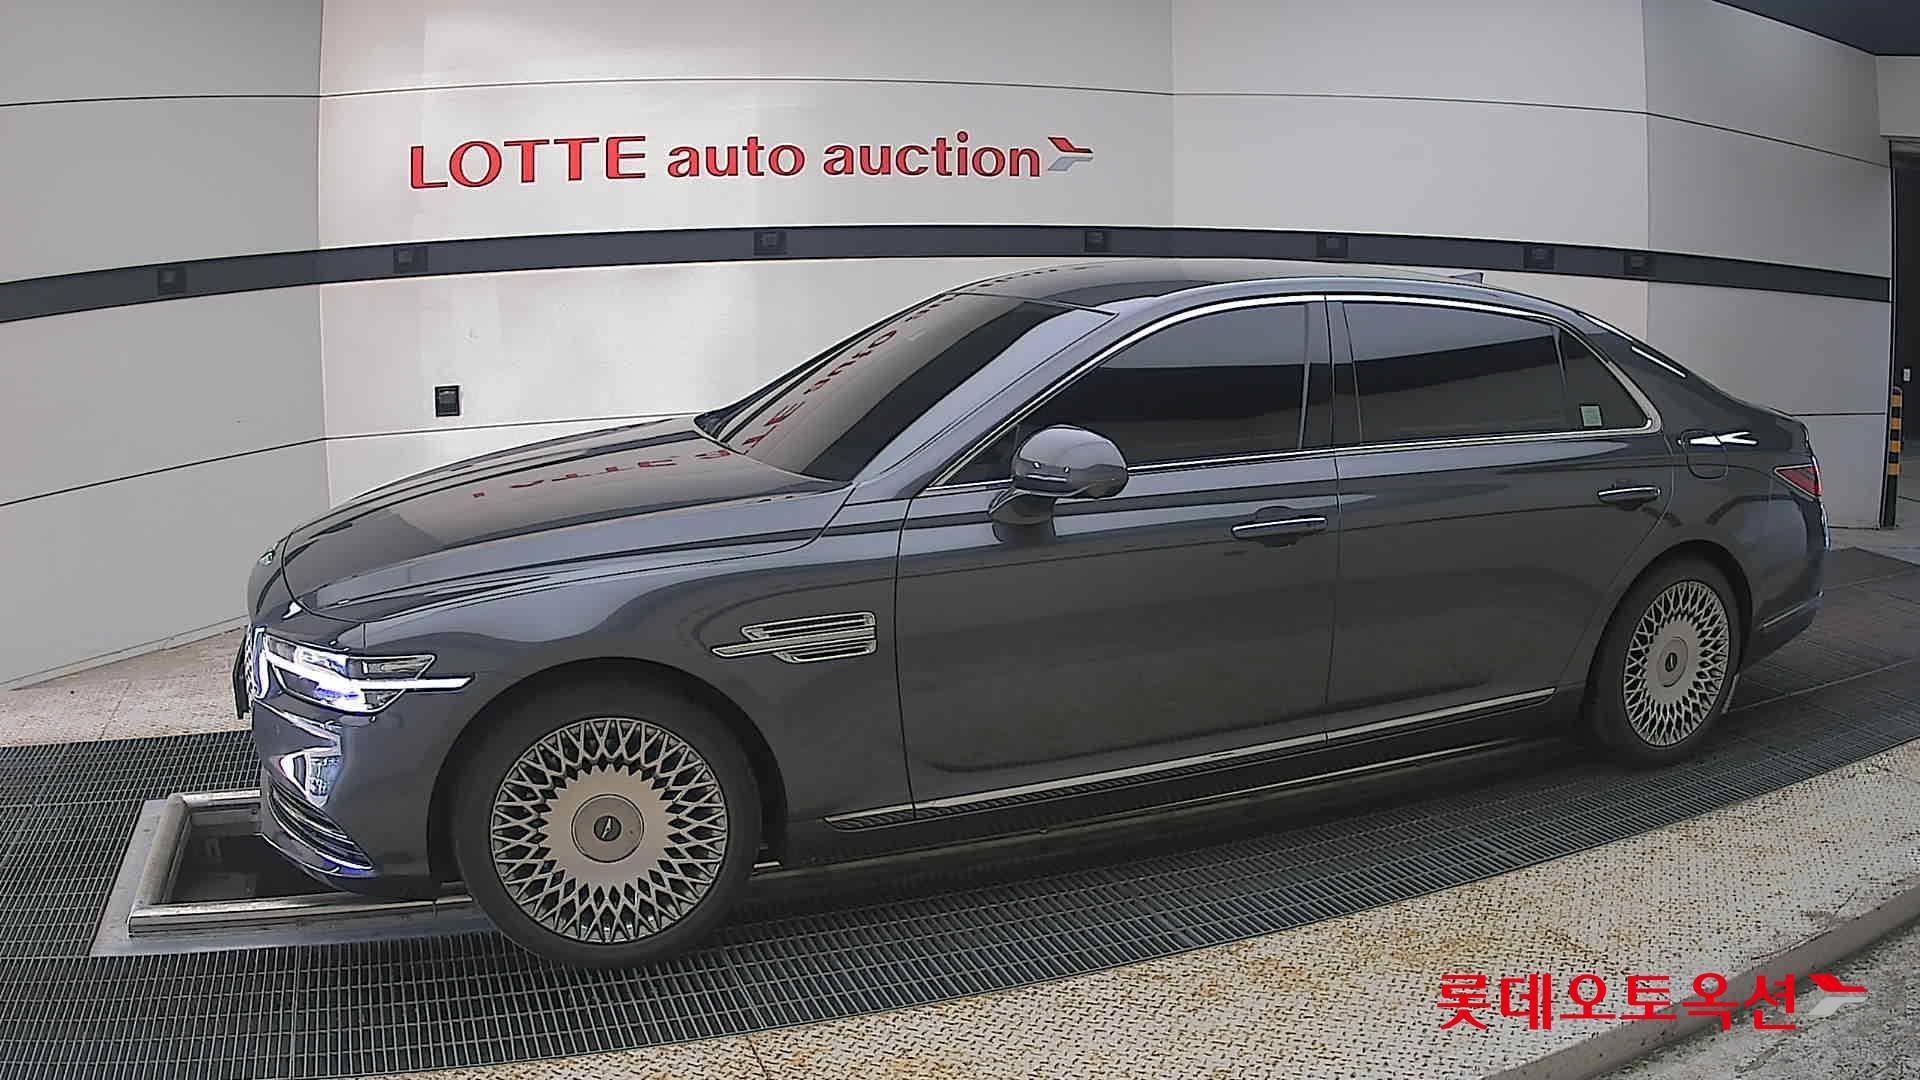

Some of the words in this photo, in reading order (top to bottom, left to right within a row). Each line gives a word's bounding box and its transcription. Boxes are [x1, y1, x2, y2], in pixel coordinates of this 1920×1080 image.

[410, 135, 645, 189] LOTTE
[667, 135, 805, 177] auto
[822, 130, 1041, 177] auction
